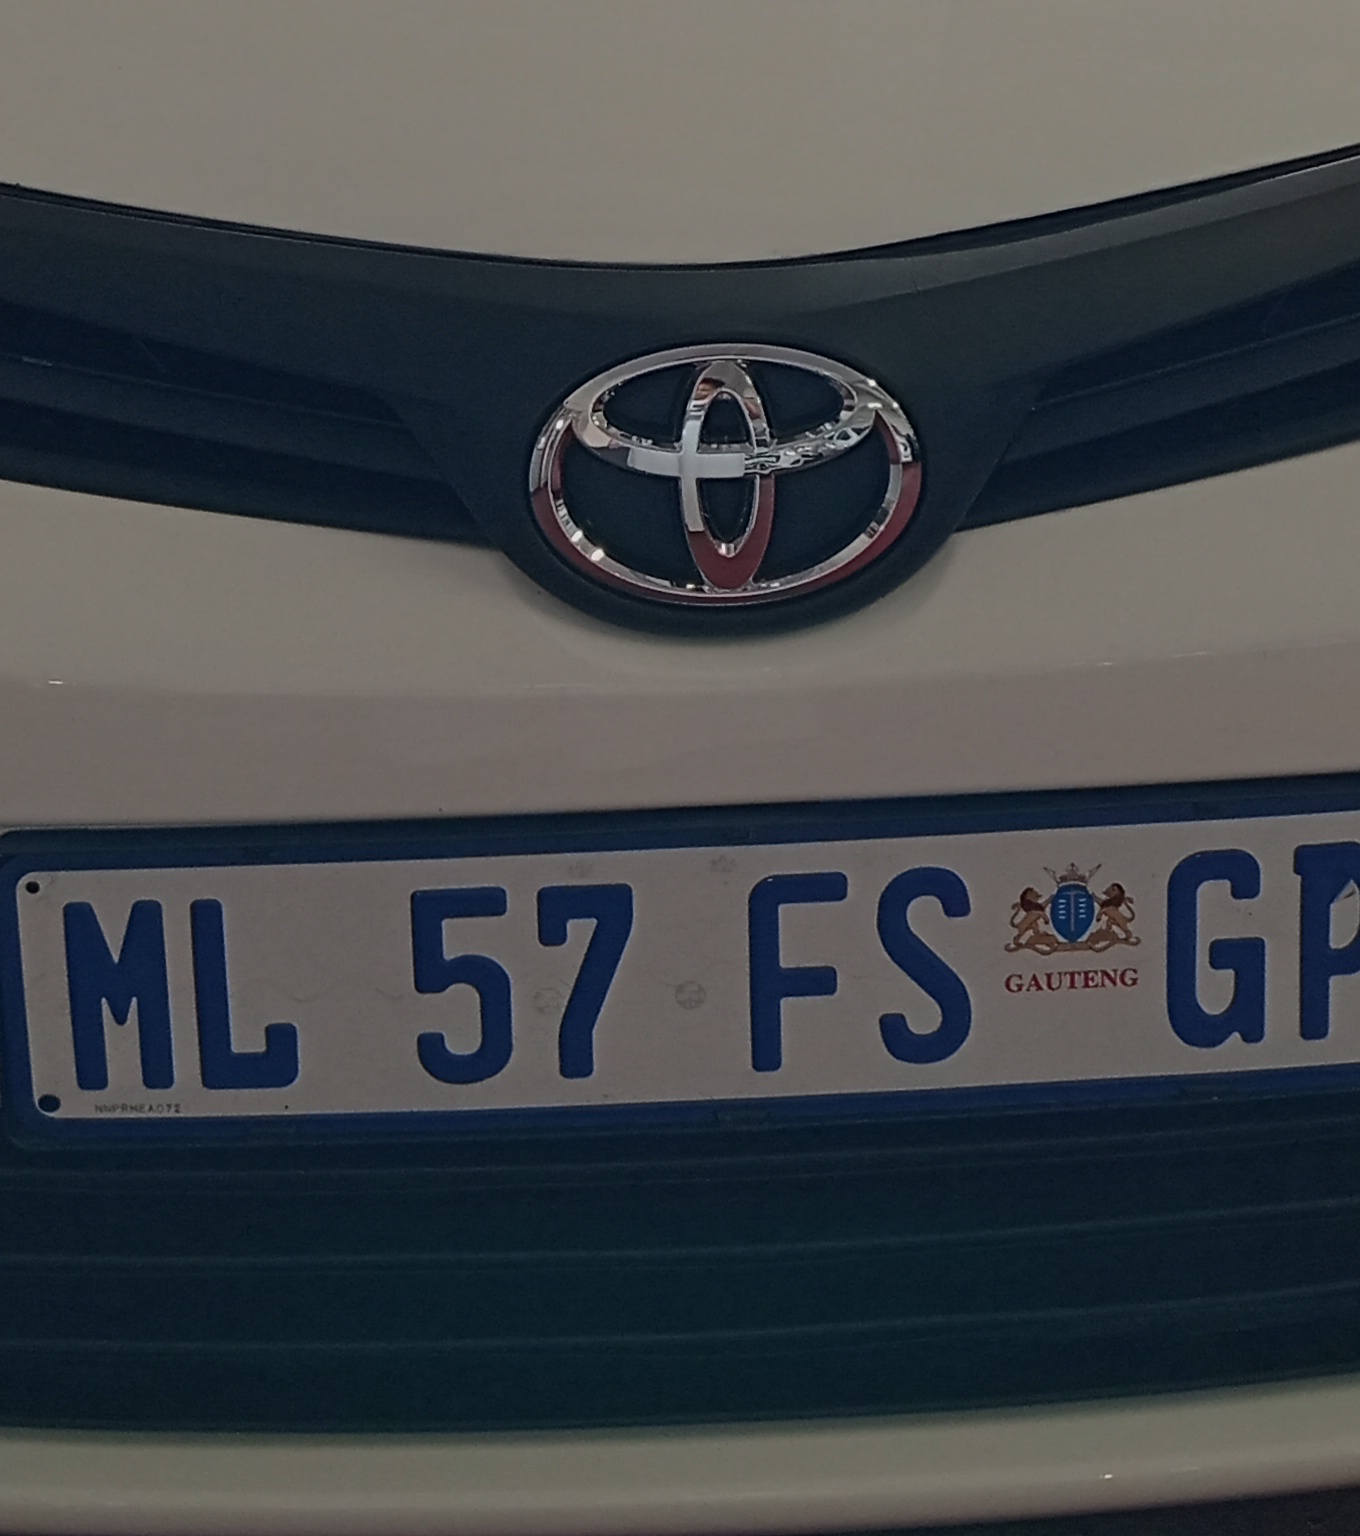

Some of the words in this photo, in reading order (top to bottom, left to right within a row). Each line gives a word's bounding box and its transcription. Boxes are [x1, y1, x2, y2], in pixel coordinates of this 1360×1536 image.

[62, 897, 300, 1092] ML
[409, 882, 635, 1085] 57
[747, 866, 973, 1065] FS
[1004, 967, 1140, 993] GAUTENG
